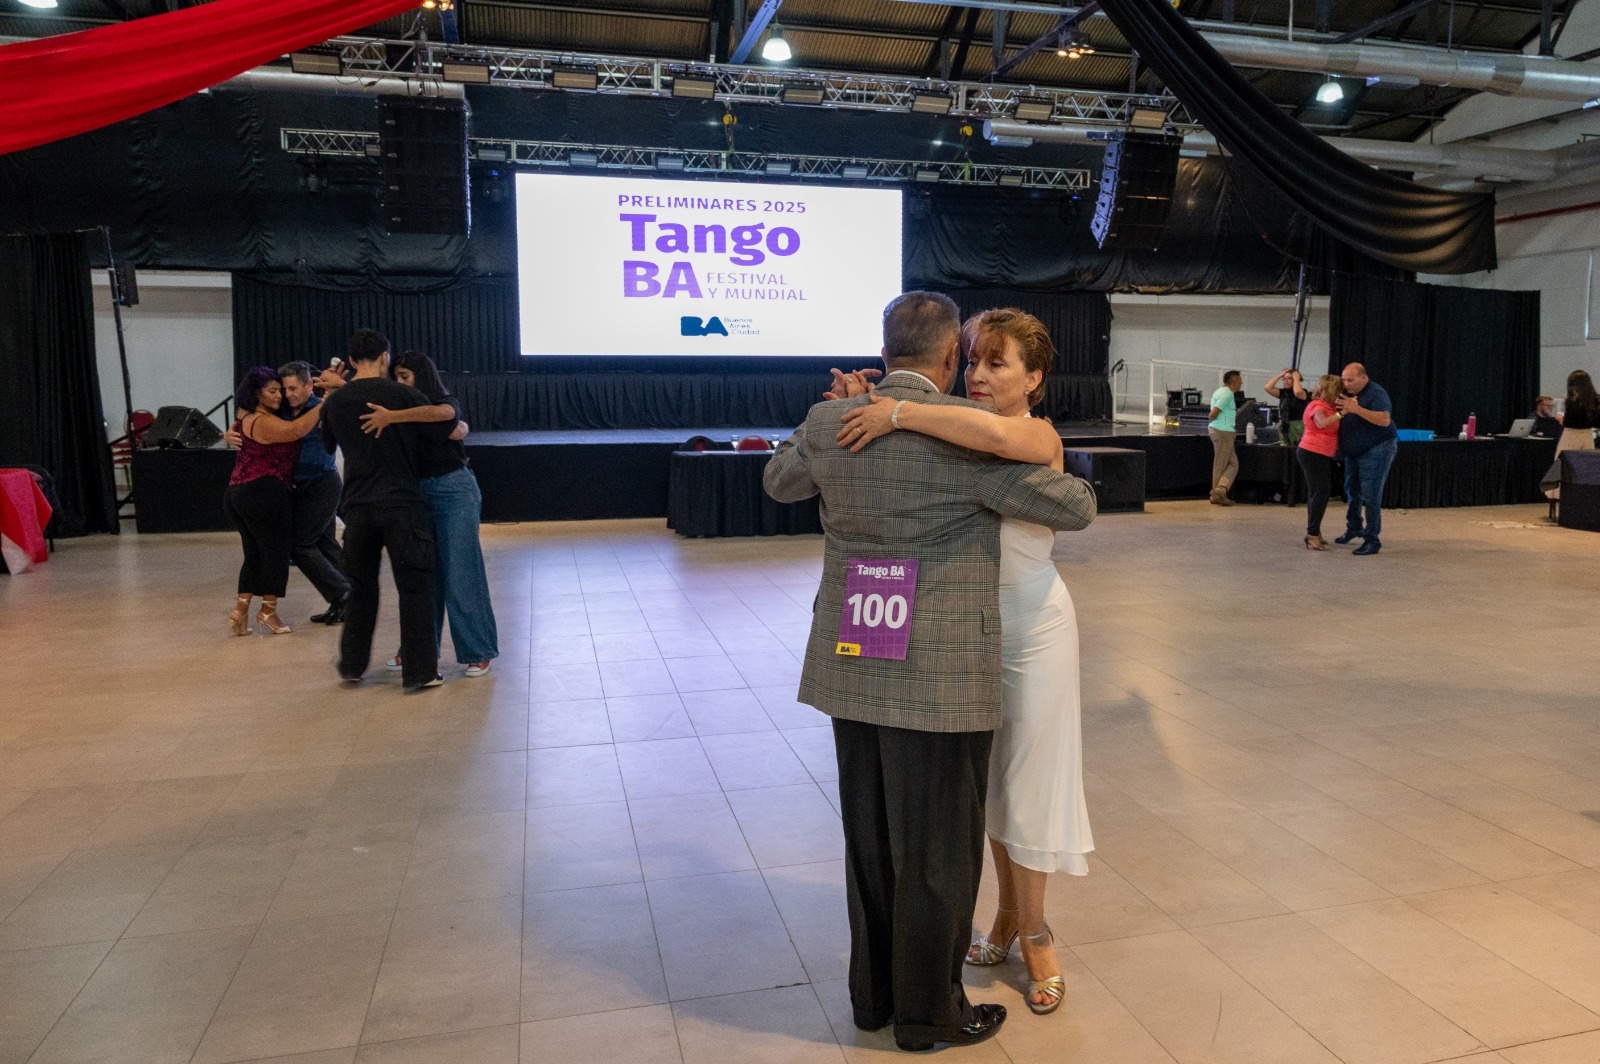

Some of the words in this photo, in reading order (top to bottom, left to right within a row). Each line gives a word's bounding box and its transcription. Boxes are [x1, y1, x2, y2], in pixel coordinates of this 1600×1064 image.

[618, 194, 757, 212] PRELIMINARES
[763, 200, 806, 214] 2025
[619, 213, 801, 267] Tango
[622, 259, 704, 299] BA
[706, 272, 788, 285] FESTIVAL
[708, 287, 718, 299] Y
[725, 287, 808, 301] MUNDIAL
[680, 316, 729, 337] BA
[857, 564, 889, 579] Tango
[890, 565, 905, 577] BA
[847, 593, 908, 629] 100
